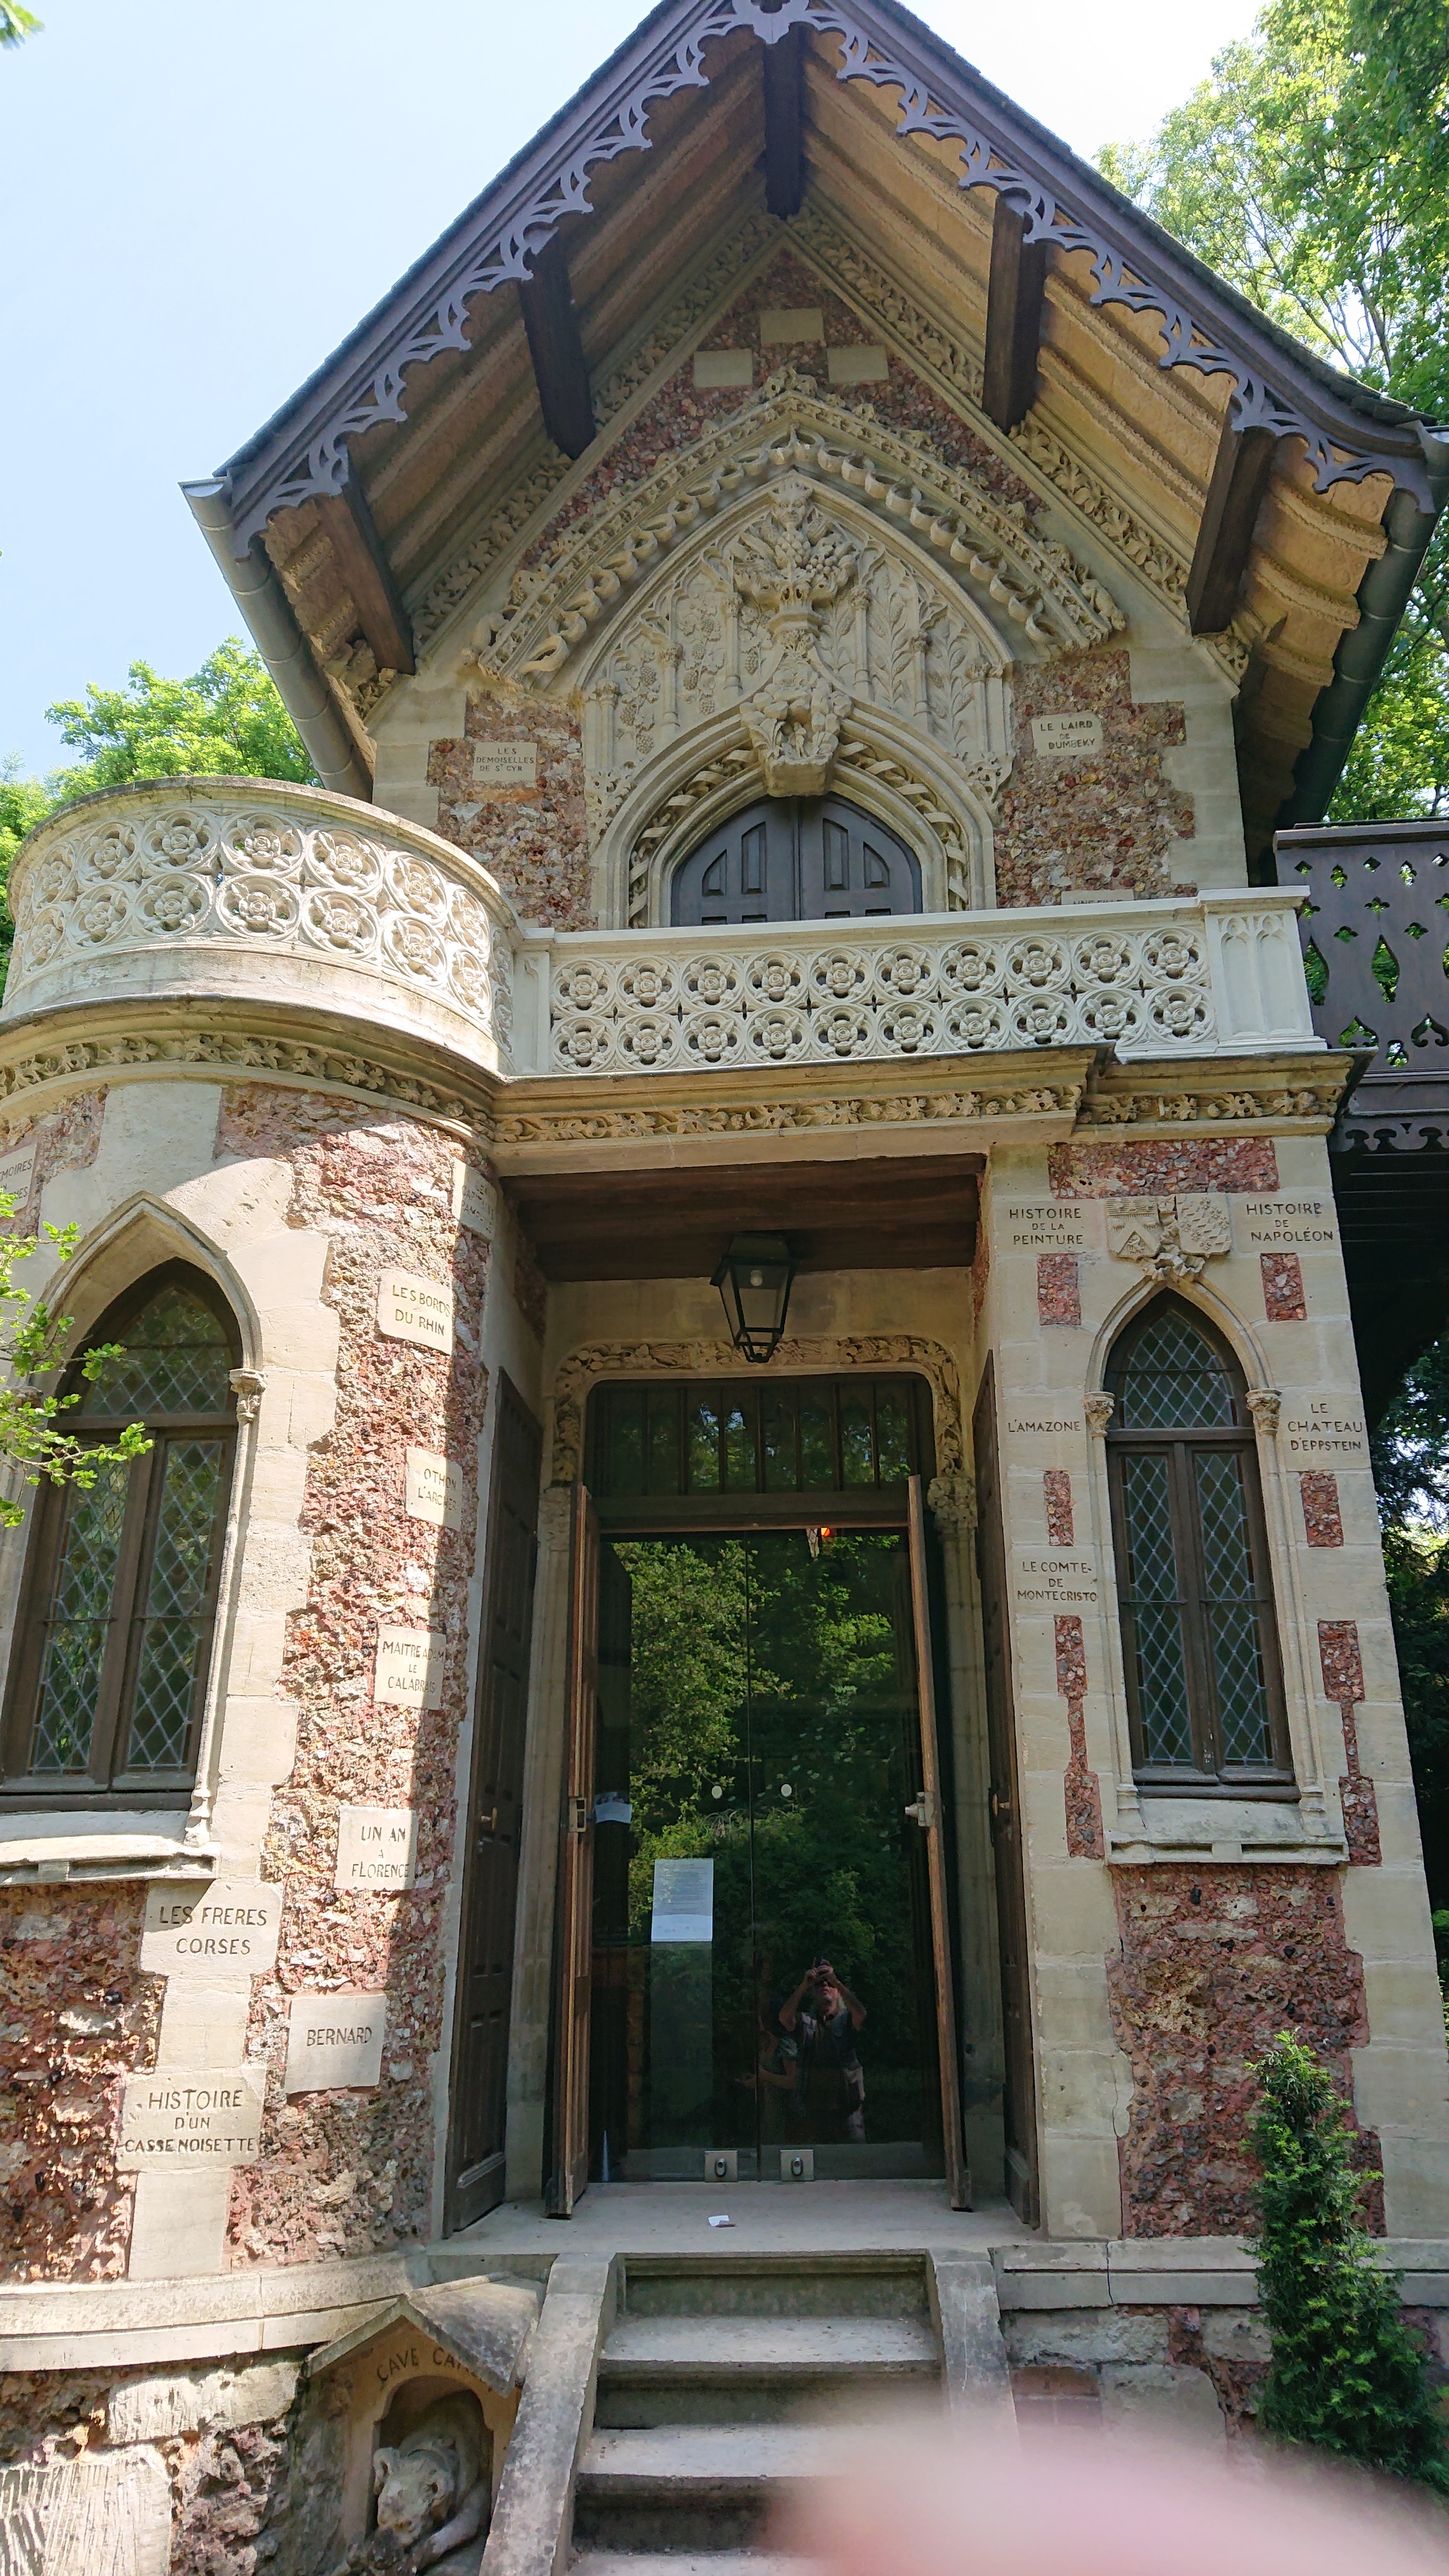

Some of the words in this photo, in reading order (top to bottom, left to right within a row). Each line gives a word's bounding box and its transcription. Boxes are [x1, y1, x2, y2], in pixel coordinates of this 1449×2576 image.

[1040, 723, 1054, 732] LE
[1061, 720, 1093, 730] LAIRD
[1010, 1208, 1082, 1219] HISTOIRE
[1246, 1202, 1324, 1215] HISTOIRE
[1013, 1235, 1083, 1245] PEINTURE
[1251, 1227, 1333, 1242] NAPOLÉON
[392, 1285, 417, 1302] LES
[419, 1292, 450, 1317] BORDS
[395, 1309, 413, 1324] DU
[419, 1316, 445, 1336] RHIN
[1311, 1403, 1328, 1413] LE
[1008, 1419, 1081, 1432] L'AMAZONE
[1288, 1421, 1362, 1432] CHATEAU
[1290, 1437, 1361, 1451] D'EPPSTEIN
[424, 1469, 456, 1490] OTHON
[1022, 1561, 1038, 1572] LE
[1041, 1562, 1088, 1573] COMTE
[1048, 1578, 1063, 1588] DE
[382, 1641, 421, 1658] MAITRE
[409, 1664, 417, 1673] LE
[388, 1676, 436, 1694] CALABRAIS
[361, 1826, 382, 1842] UN
[388, 1827, 406, 1843] AN
[378, 1849, 384, 1859] A
[351, 1861, 410, 1878] FLORENCE
[159, 1906, 193, 1925] LES
[201, 1907, 268, 1926] FRERES
[176, 1938, 250, 1955] CORSES
[307, 2027, 373, 2047] BERNARD
[148, 2089, 243, 2110] HISTOIRE
[174, 2111, 210, 2130] D'UN
[376, 2348, 419, 2382] CAVE
